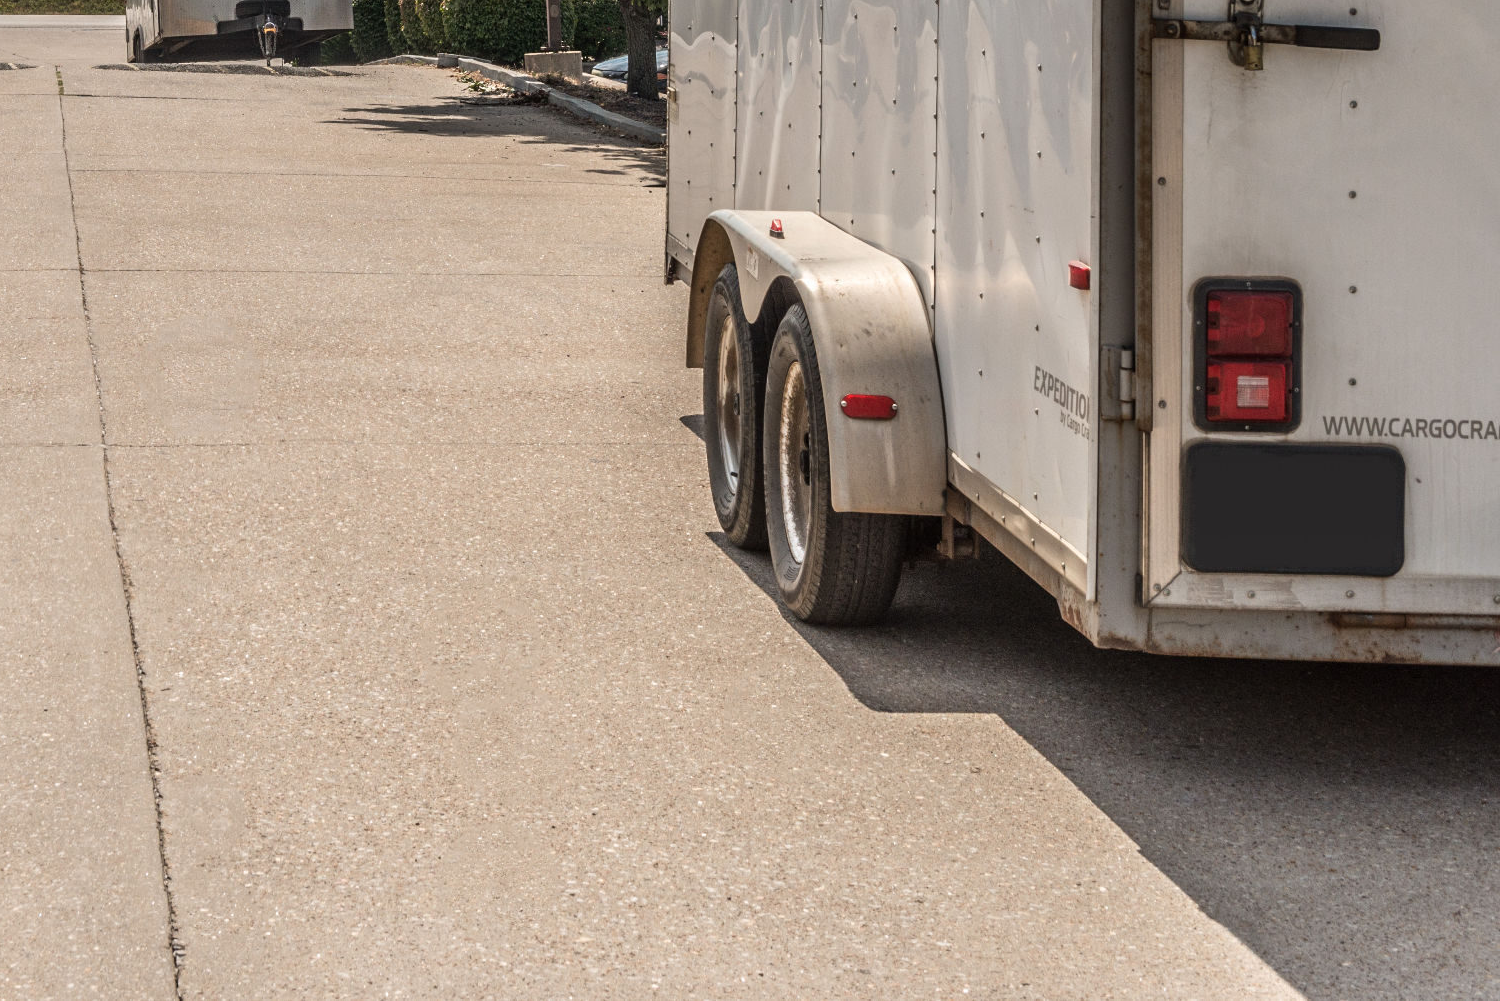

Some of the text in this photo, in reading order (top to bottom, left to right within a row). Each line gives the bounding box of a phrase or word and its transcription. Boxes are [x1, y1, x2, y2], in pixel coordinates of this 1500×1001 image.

[1060, 410, 1066, 427] by
[1066, 413, 1081, 435] Cargo
[1322, 415, 1500, 440] WWW.CARGOCRA
